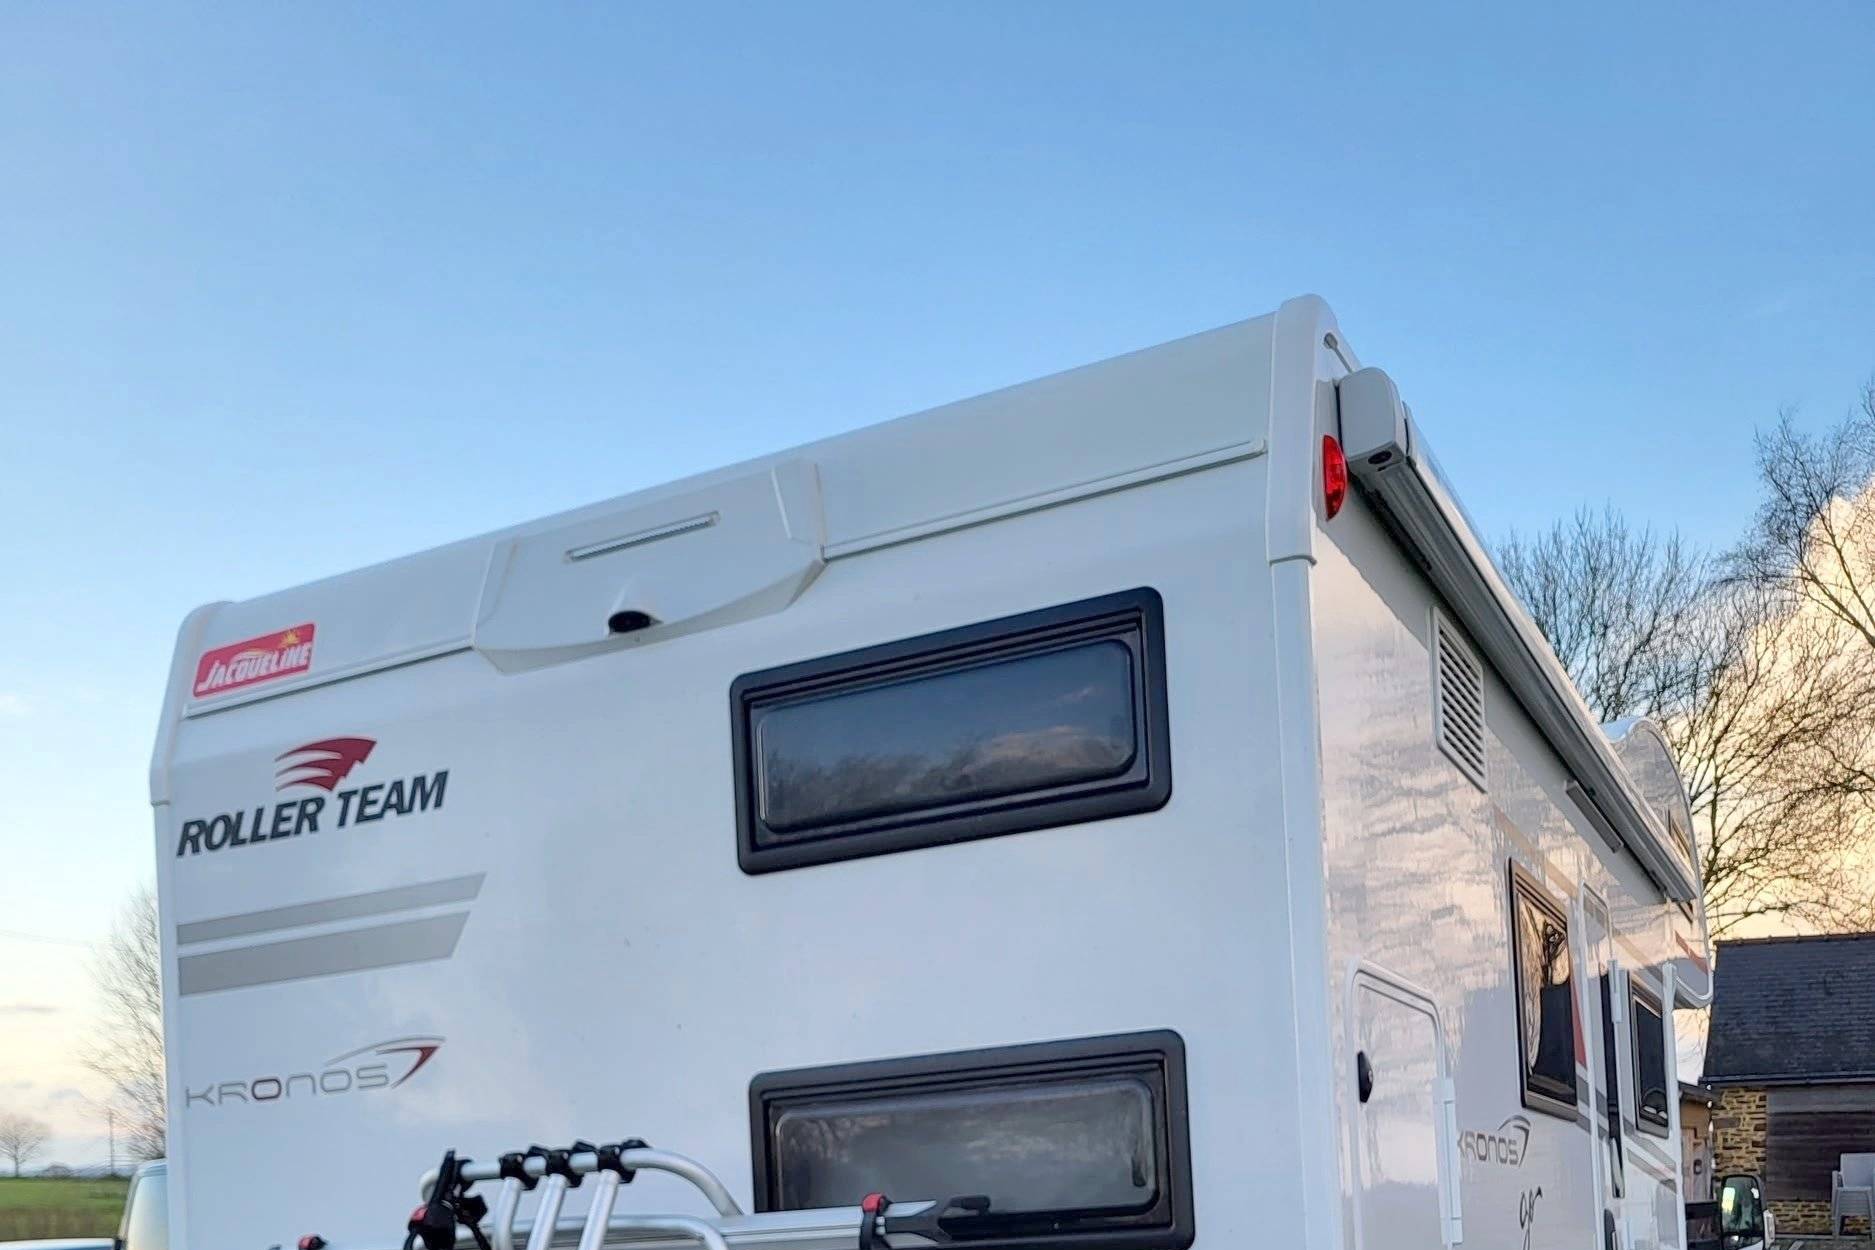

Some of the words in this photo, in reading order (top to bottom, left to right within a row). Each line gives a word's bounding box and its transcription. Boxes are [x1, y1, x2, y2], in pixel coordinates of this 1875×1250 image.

[177, 797, 325, 857] ROLLER
[337, 770, 449, 828] TEAM
[186, 1063, 389, 1108] KRONOS
